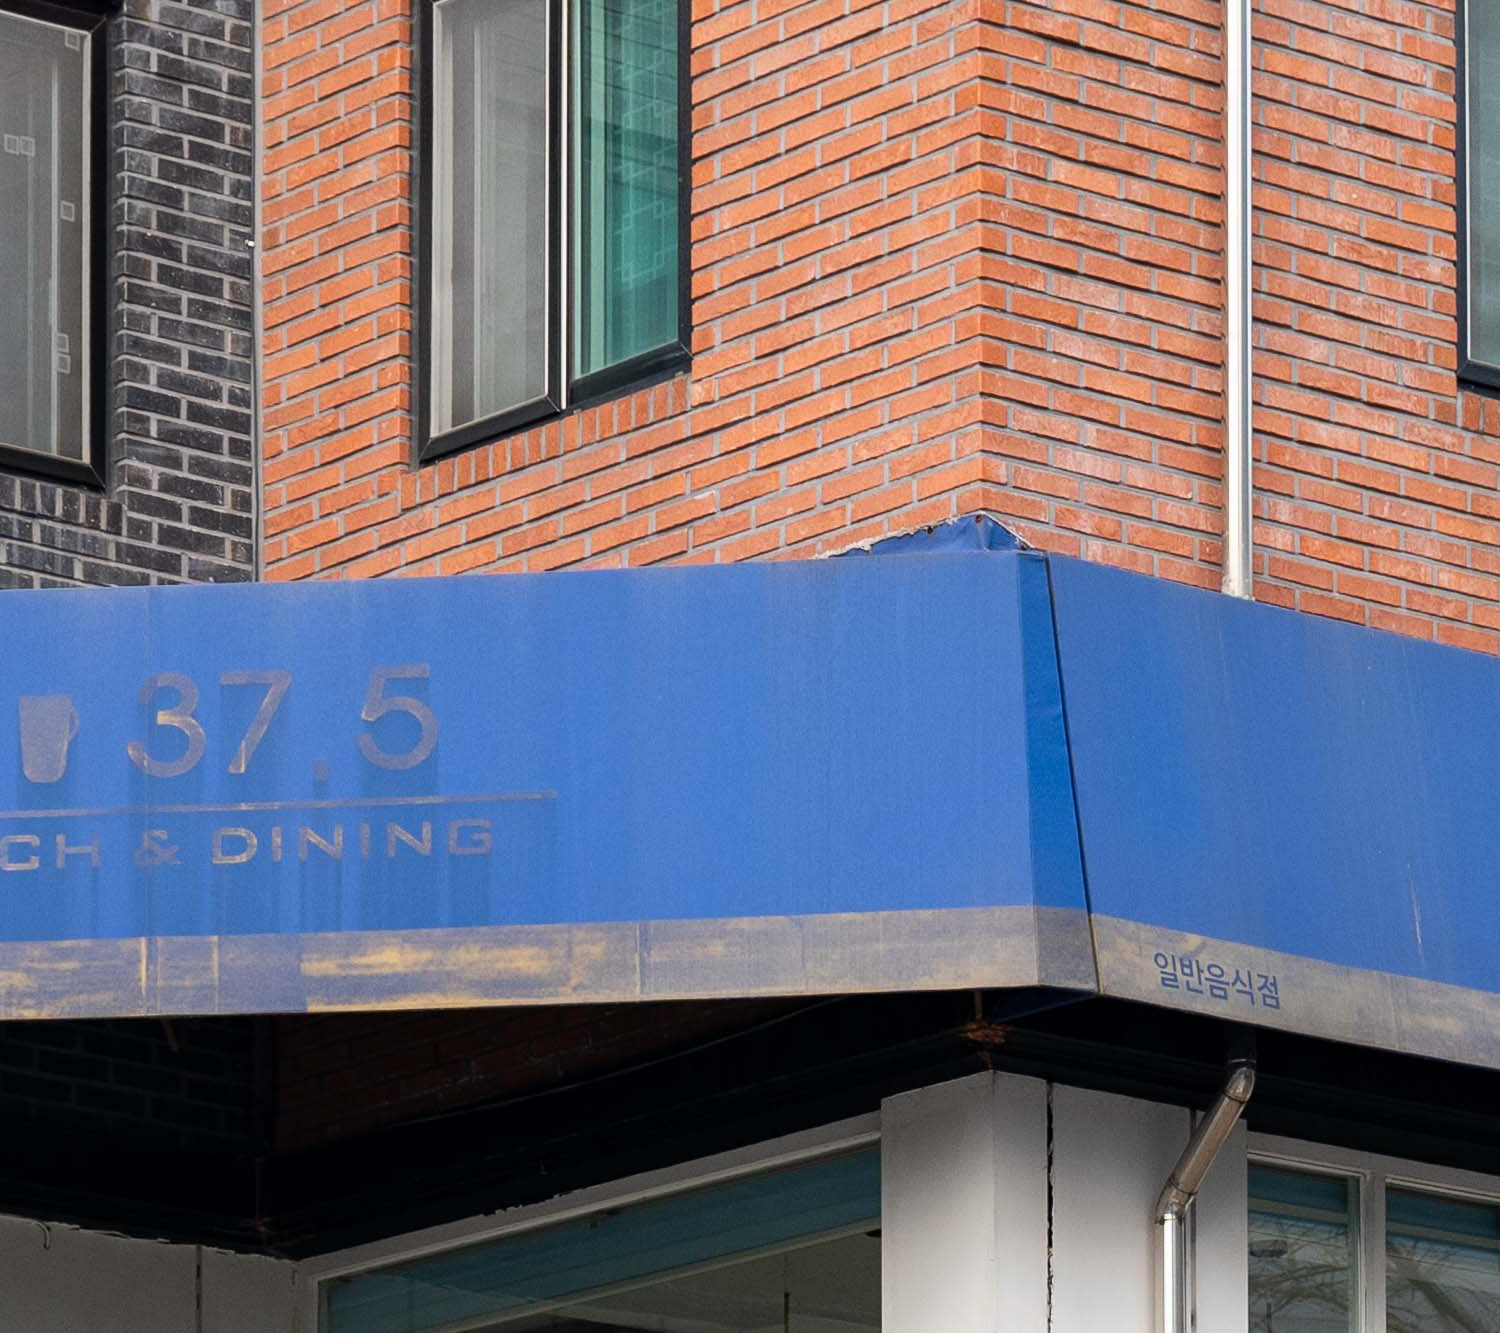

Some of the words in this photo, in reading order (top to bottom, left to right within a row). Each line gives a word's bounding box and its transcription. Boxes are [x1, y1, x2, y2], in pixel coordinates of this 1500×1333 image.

[132, 828, 182, 867] &
[211, 817, 494, 865] DINING
[1154, 952, 1280, 1009] 일반음식점
